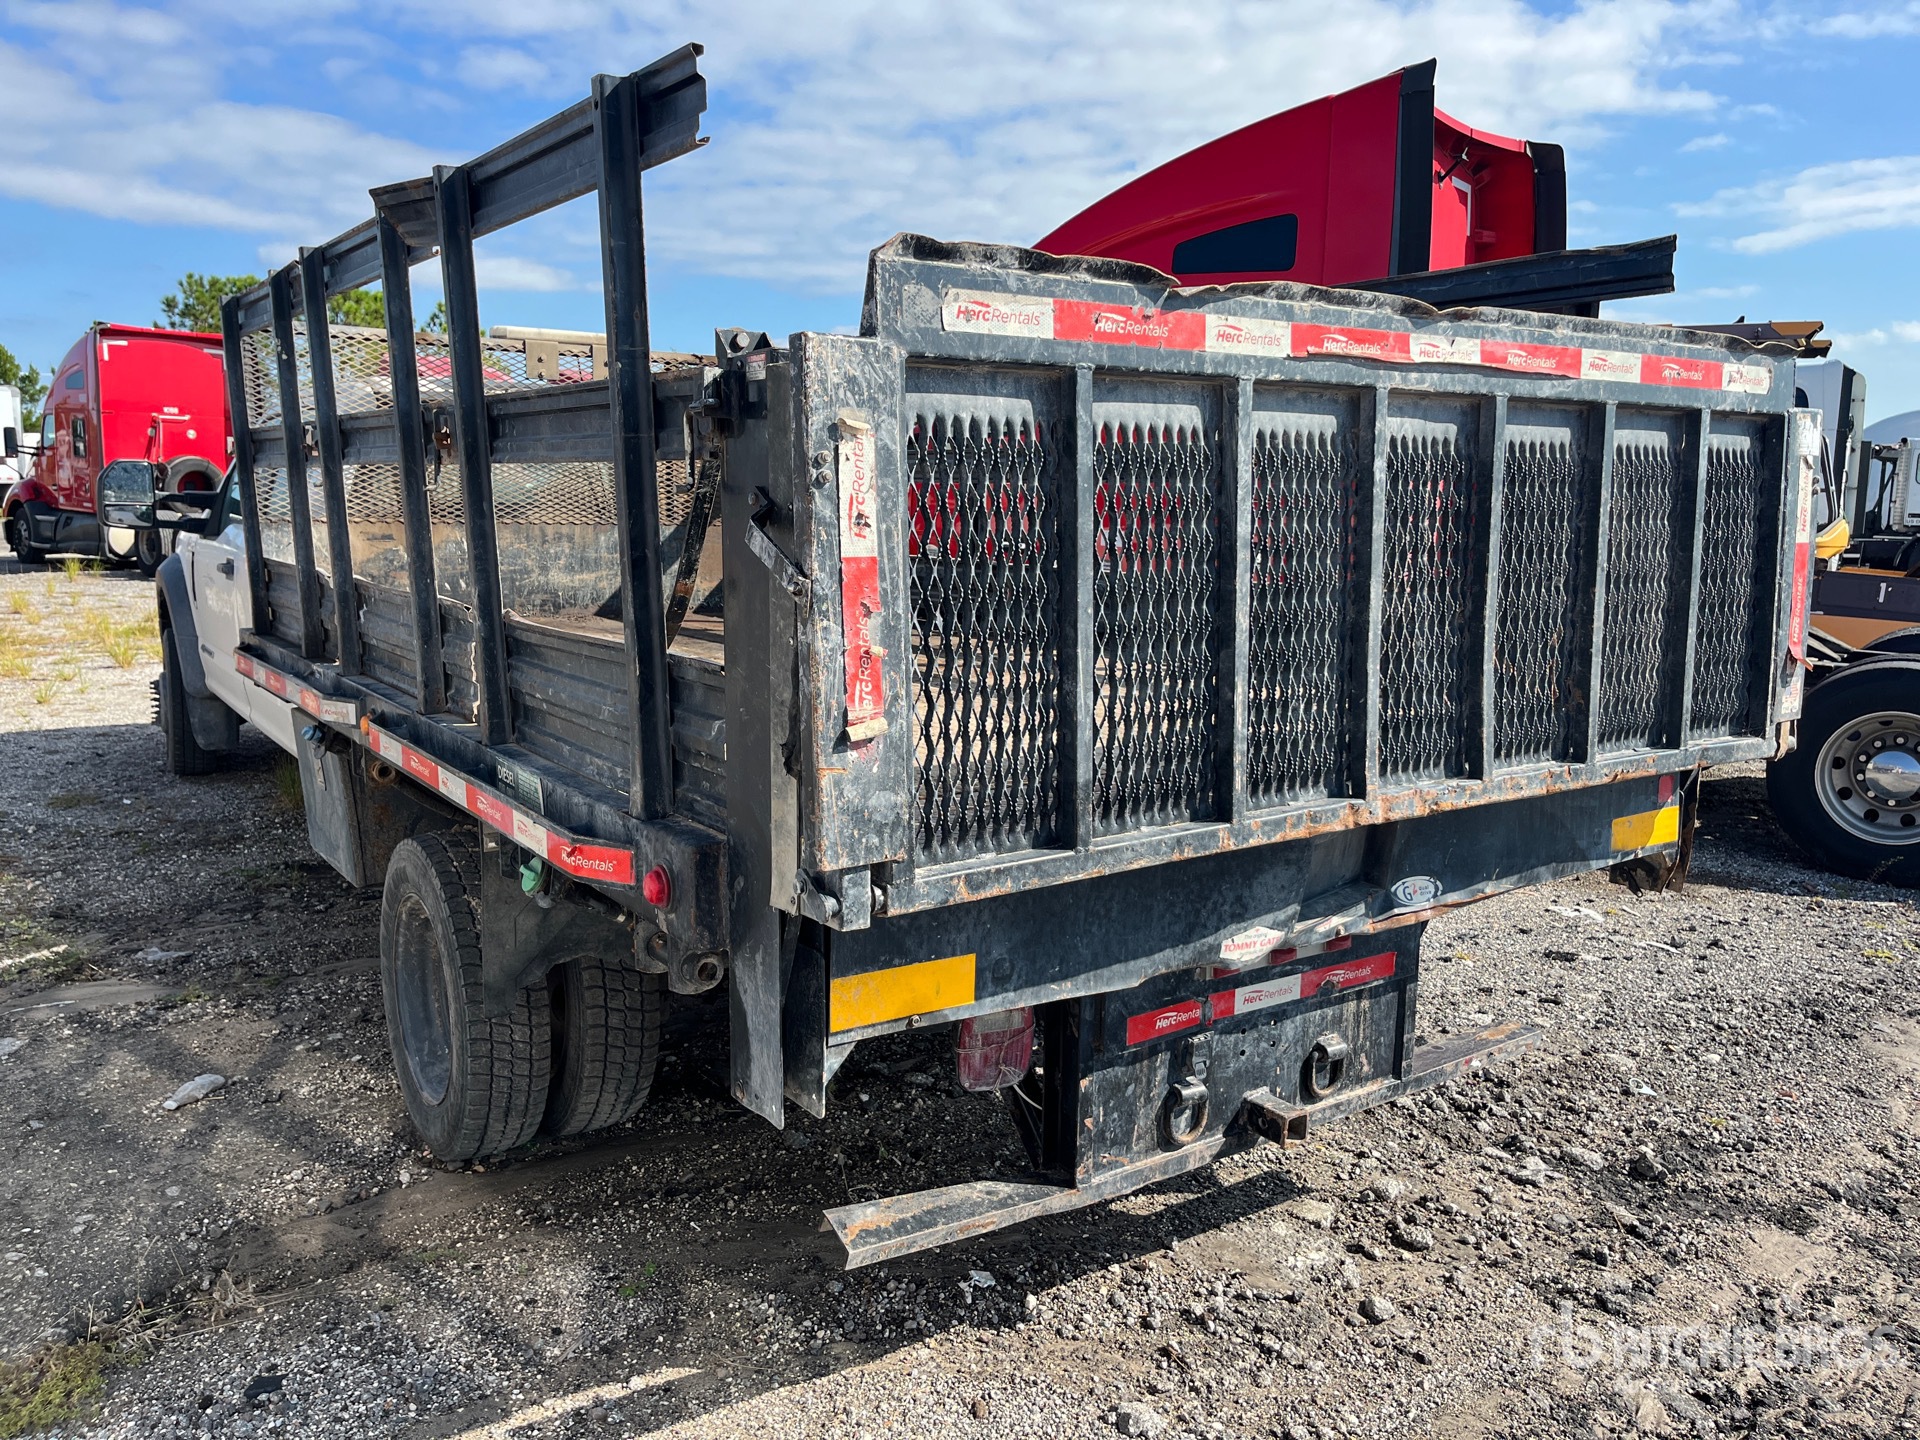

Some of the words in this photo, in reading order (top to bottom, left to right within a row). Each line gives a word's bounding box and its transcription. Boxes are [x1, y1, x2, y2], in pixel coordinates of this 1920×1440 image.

[956, 304, 1041, 326] HercRentals
[1094, 318, 1169, 338] HercRentals
[1216, 328, 1282, 347] HercRentals
[1323, 339, 1381, 355] HercRentals
[1506, 354, 1557, 368] HercRentals
[1588, 361, 1634, 374] HercRentals
[857, 616, 873, 709] ercRentals
[1224, 941, 1258, 953] TOMMY
[1243, 986, 1292, 1006] HercRentals
[1155, 1007, 1200, 1030] HercRenta
